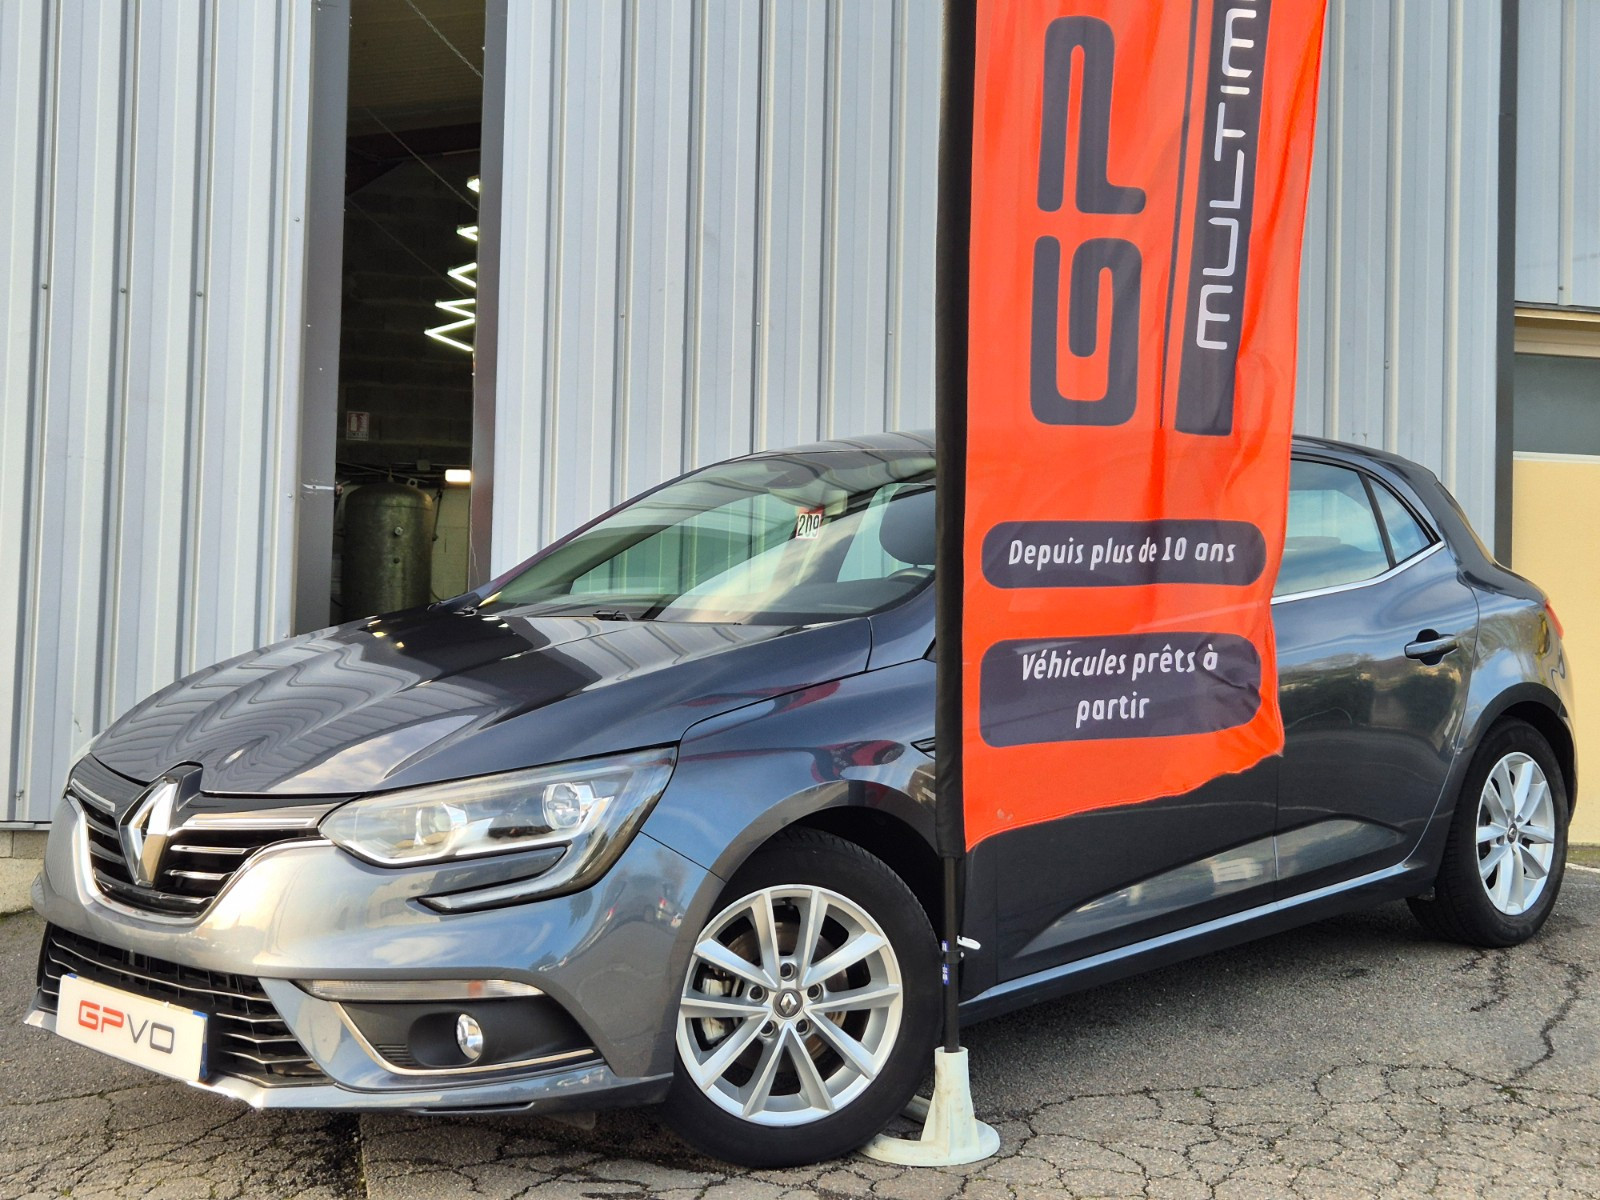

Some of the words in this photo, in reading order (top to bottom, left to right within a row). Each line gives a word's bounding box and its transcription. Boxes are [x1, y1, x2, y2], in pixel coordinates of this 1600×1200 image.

[1196, 0, 1258, 350] MULTIM
[1030, 15, 1147, 427] GP
[797, 514, 820, 537] 209
[1008, 536, 1085, 571] Depuis
[1089, 537, 1135, 571] plus
[1138, 536, 1158, 563] de
[1161, 536, 1188, 561] 10
[1194, 542, 1237, 563] ans
[1022, 648, 1128, 681] Véhicules
[1131, 643, 1196, 682] prêts
[1202, 643, 1219, 671] à
[1075, 691, 1150, 729] partir
